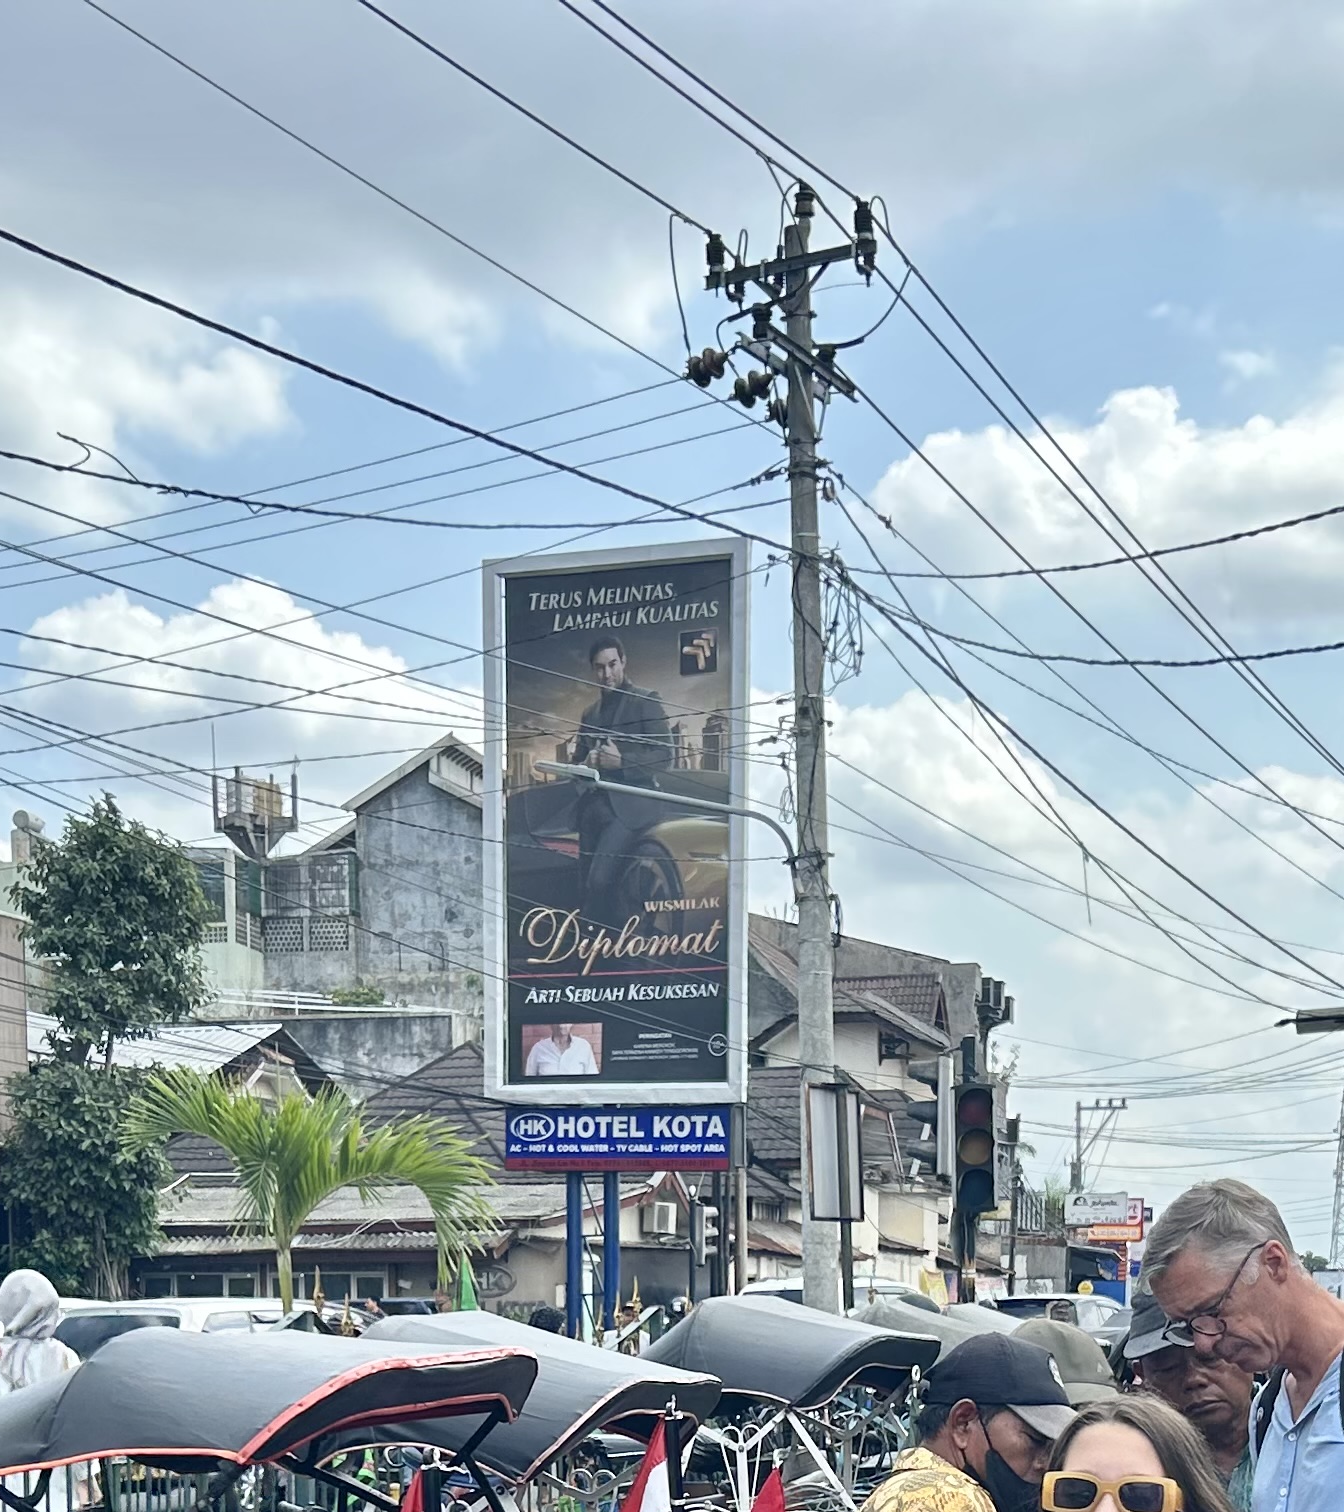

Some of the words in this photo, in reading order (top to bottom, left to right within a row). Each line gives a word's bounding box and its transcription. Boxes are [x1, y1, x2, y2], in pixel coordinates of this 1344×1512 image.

[529, 591, 582, 611] TERUS
[553, 611, 631, 632] LAMPAUI
[637, 601, 719, 625] KUALITAS
[644, 897, 720, 913] WISMILAK
[519, 907, 724, 976] Diplomat
[525, 986, 560, 1004] ARTI
[565, 985, 624, 1003] SEBUAH
[628, 983, 720, 1001] KESUKSESAN
[519, 1119, 547, 1135] HK
[557, 1116, 645, 1138] HOTEL
[653, 1115, 726, 1138] KOTA
[510, 1144, 522, 1152] AC
[529, 1144, 546, 1152] HOT
[548, 1144, 554, 1152] &
[557, 1144, 579, 1152] COOL
[580, 1144, 609, 1152] WATER
[616, 1144, 628, 1152] TV
[628, 1144, 653, 1152] CABLE
[660, 1144, 678, 1152] HOT
[680, 1144, 702, 1152] SPOT
[703, 1144, 725, 1152] AREA
